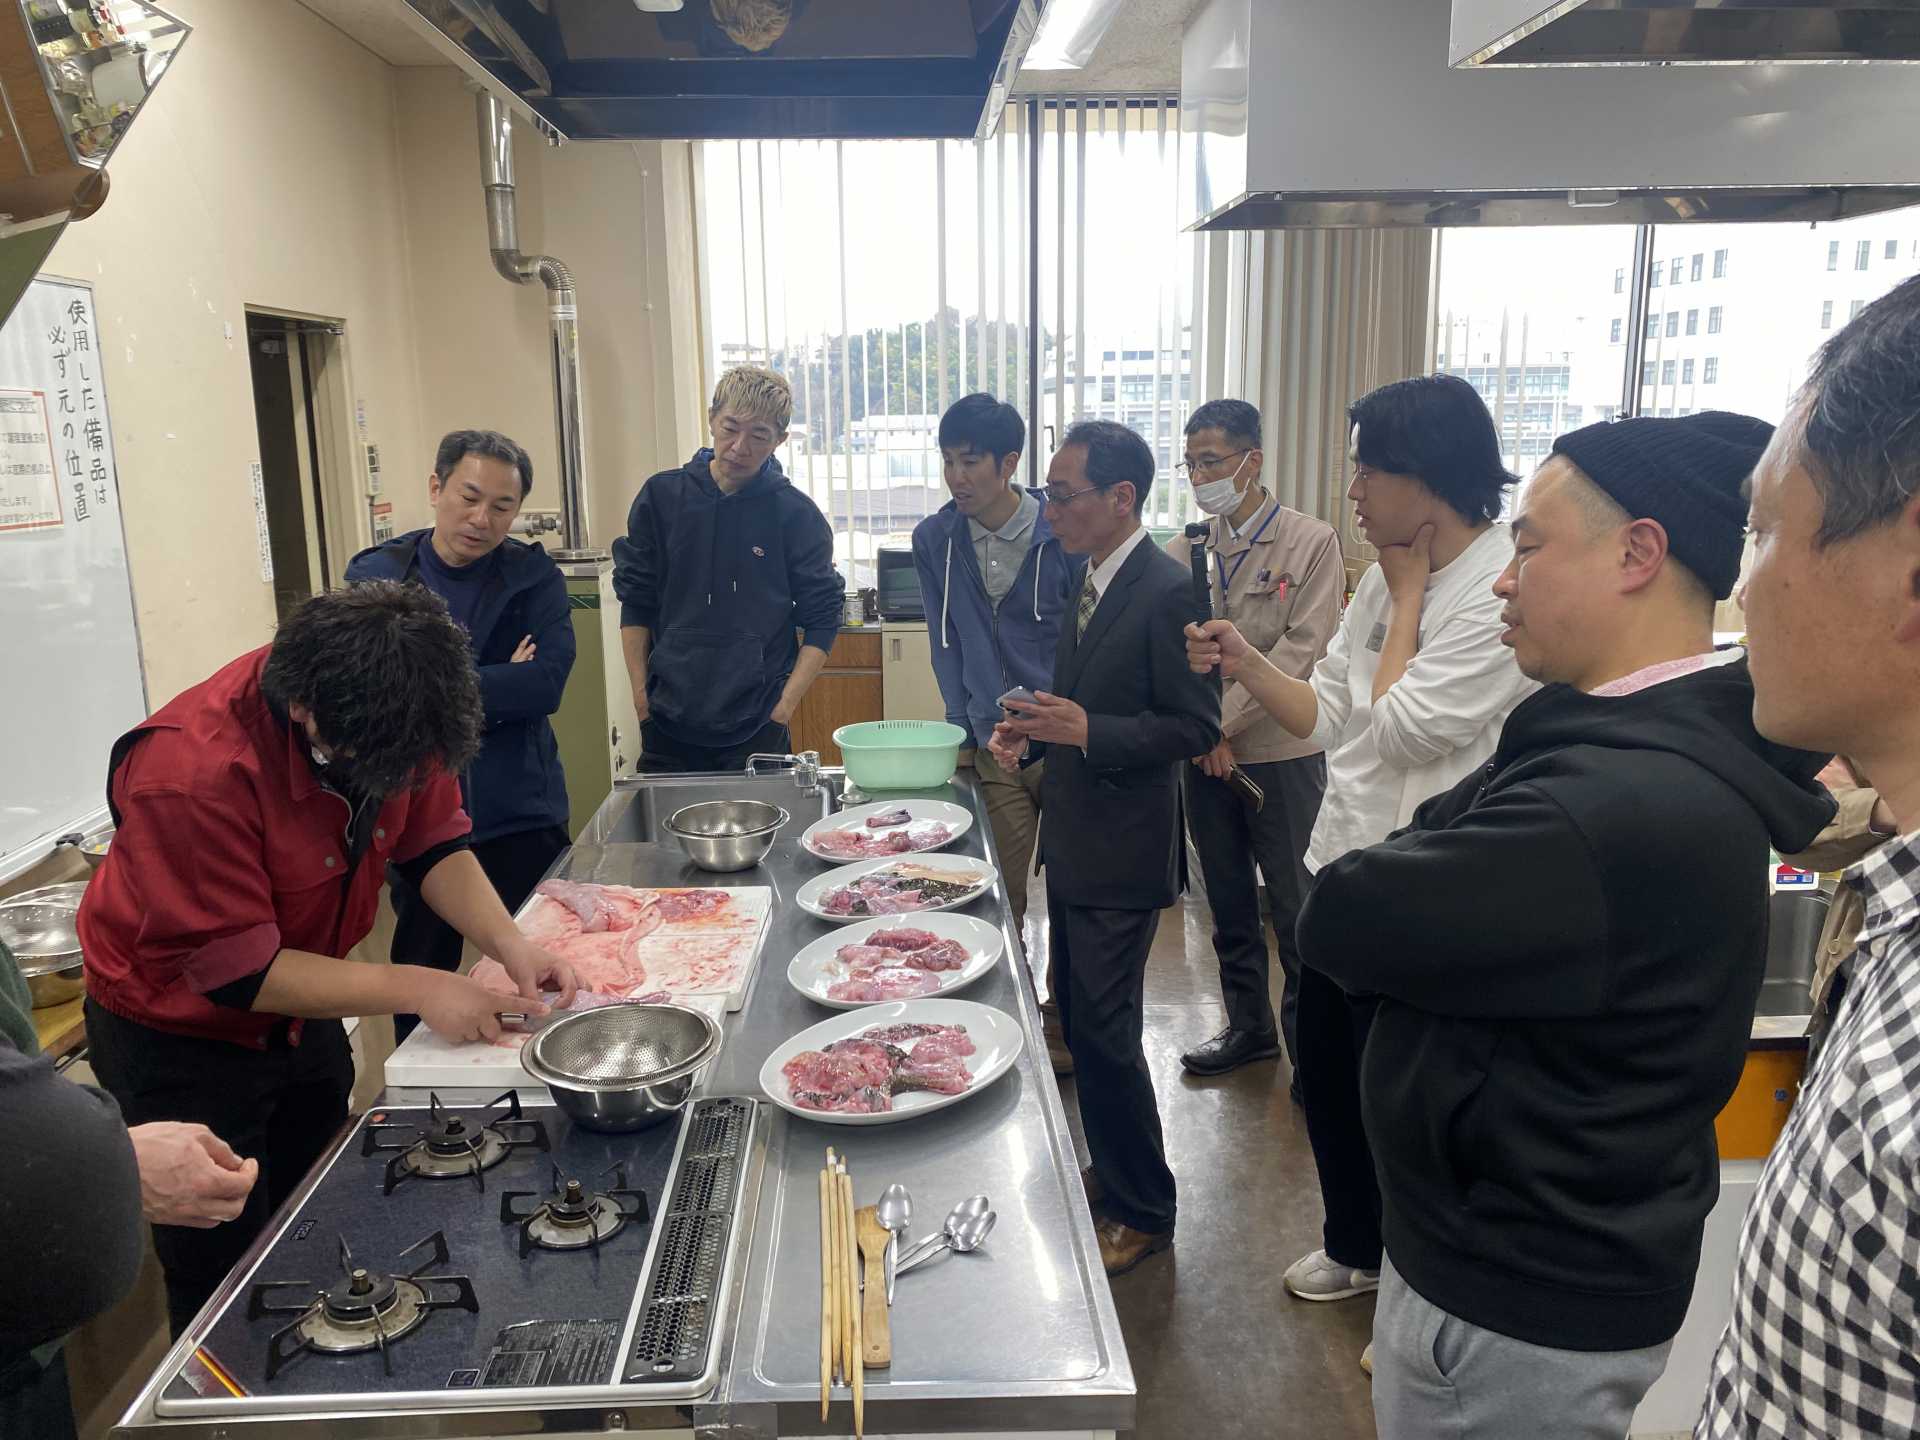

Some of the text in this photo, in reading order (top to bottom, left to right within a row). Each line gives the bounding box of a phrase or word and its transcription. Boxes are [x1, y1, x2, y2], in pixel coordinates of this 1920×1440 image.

[47, 325, 91, 522] 必ず元の位置
[67, 299, 107, 504] 使用した備品は
